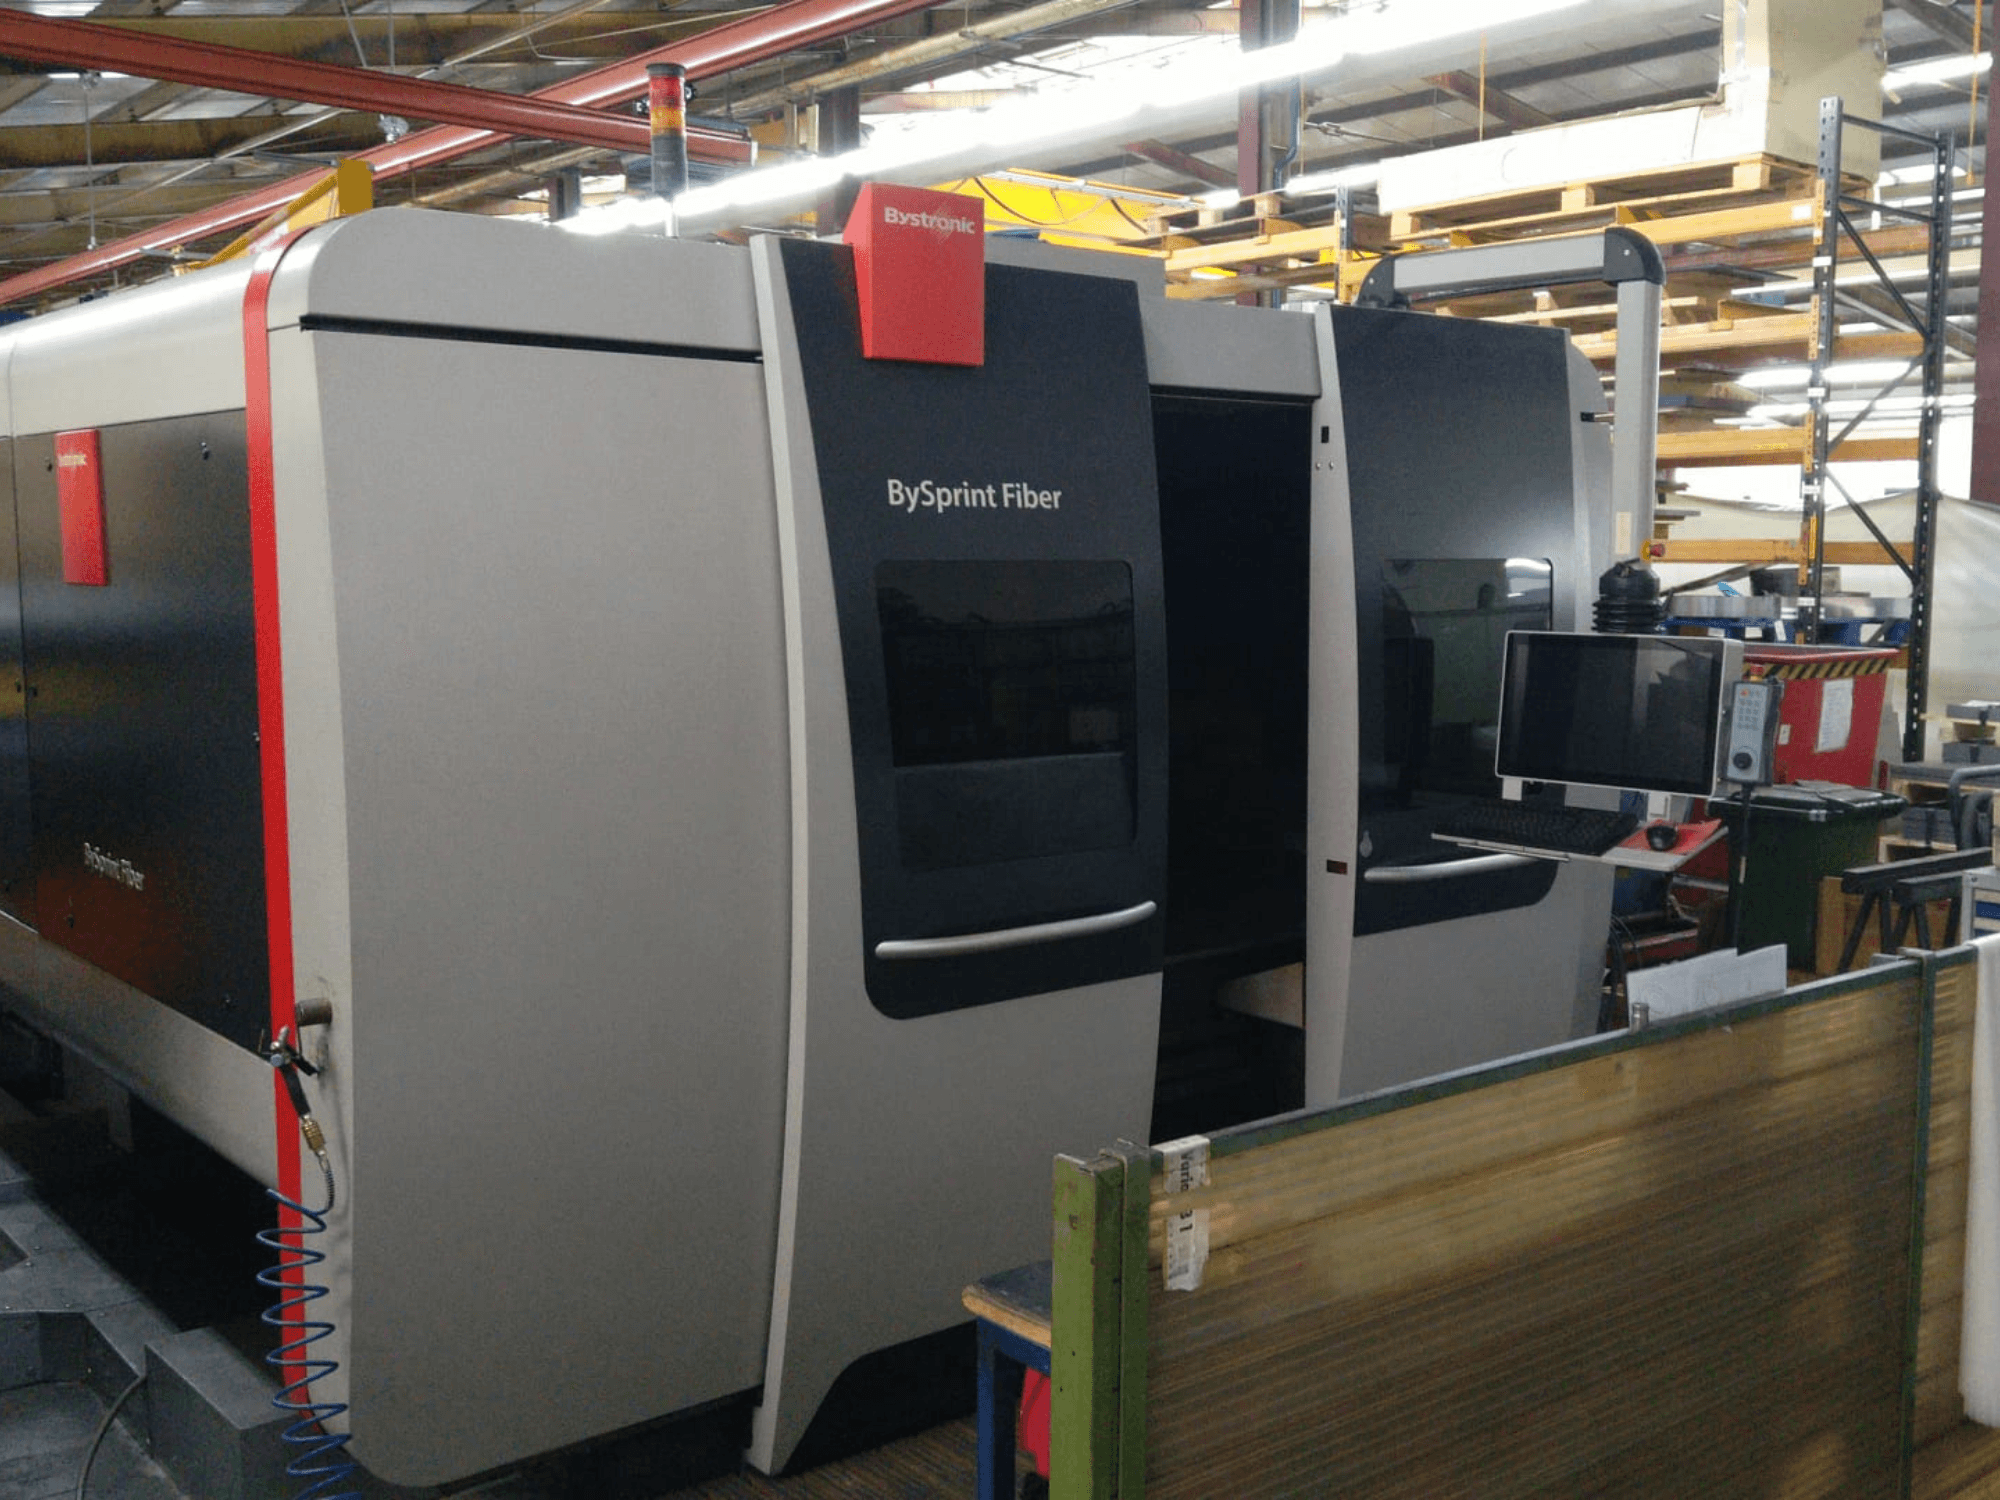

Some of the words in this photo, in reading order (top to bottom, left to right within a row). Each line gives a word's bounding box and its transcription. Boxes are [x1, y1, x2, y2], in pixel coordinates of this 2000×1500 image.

[884, 206, 976, 235] Bystronic
[887, 478, 998, 514] BySprint
[1001, 481, 1063, 509] Fiber
